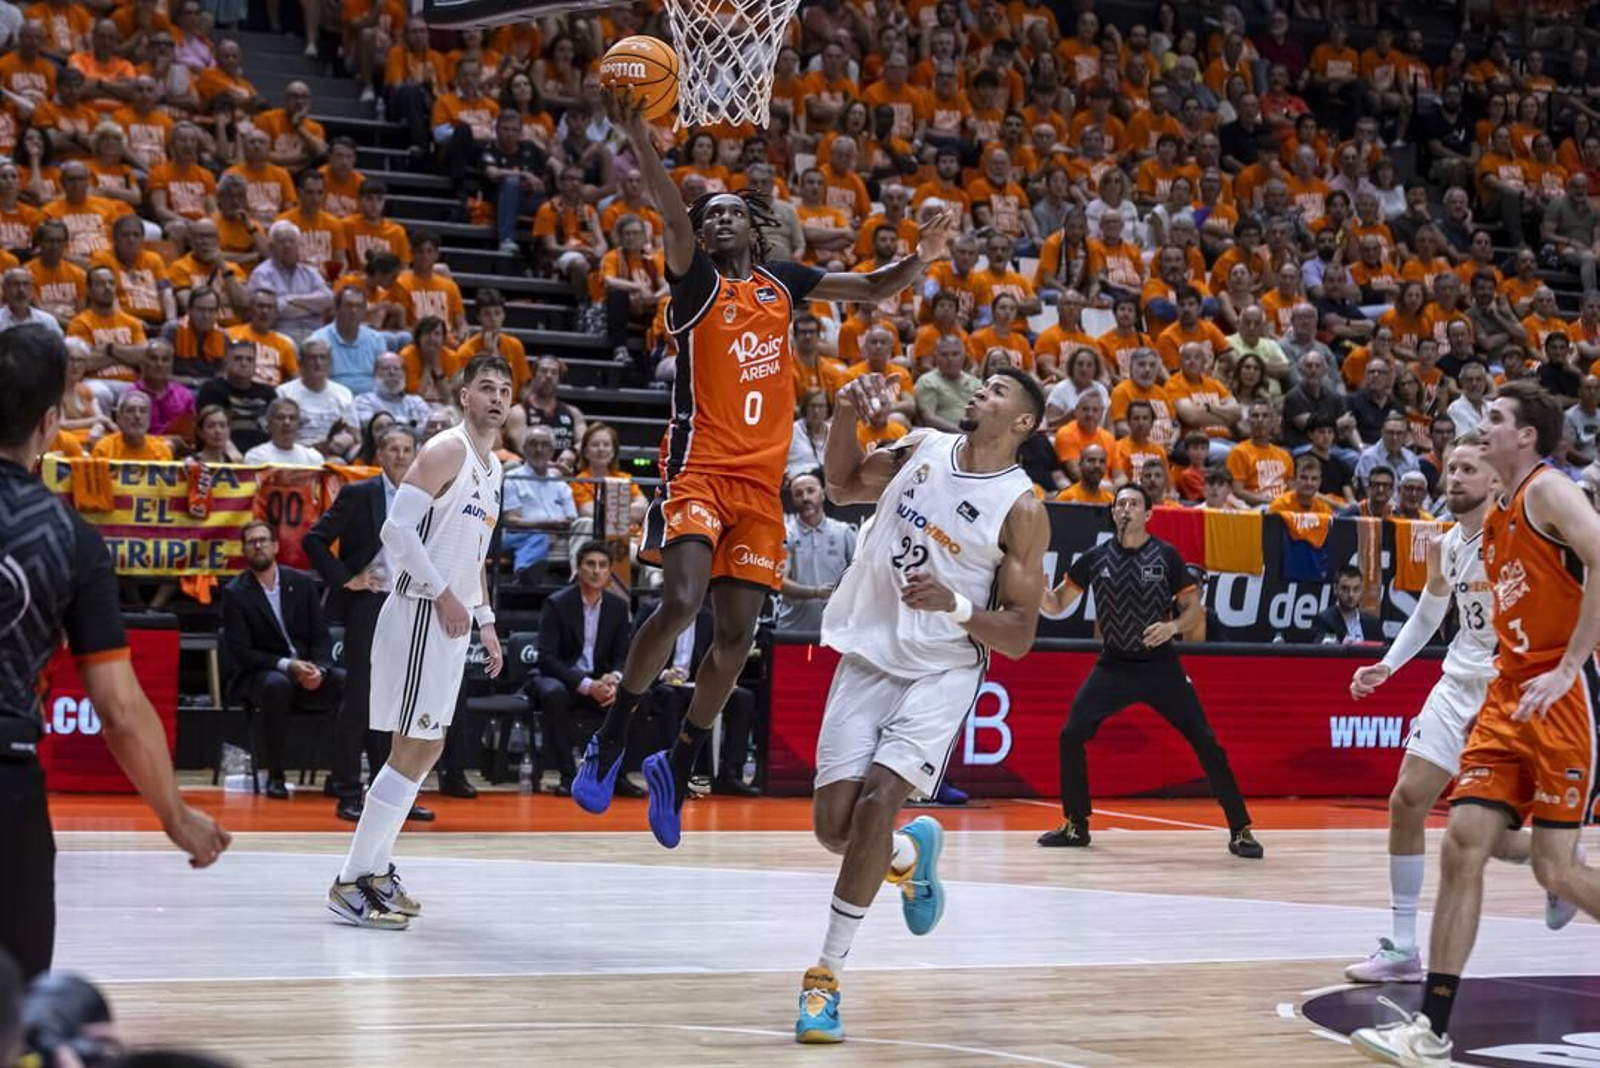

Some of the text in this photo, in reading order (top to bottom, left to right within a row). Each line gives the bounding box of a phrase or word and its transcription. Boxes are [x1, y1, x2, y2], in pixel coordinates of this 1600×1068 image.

[739, 359, 780, 384] ARENA
[744, 391, 763, 425] 0
[135, 498, 174, 523] EL
[103, 540, 227, 569] TRIPLE
[892, 536, 929, 573] 22
[1463, 601, 1485, 631] 13
[1507, 617, 1530, 653] 3
